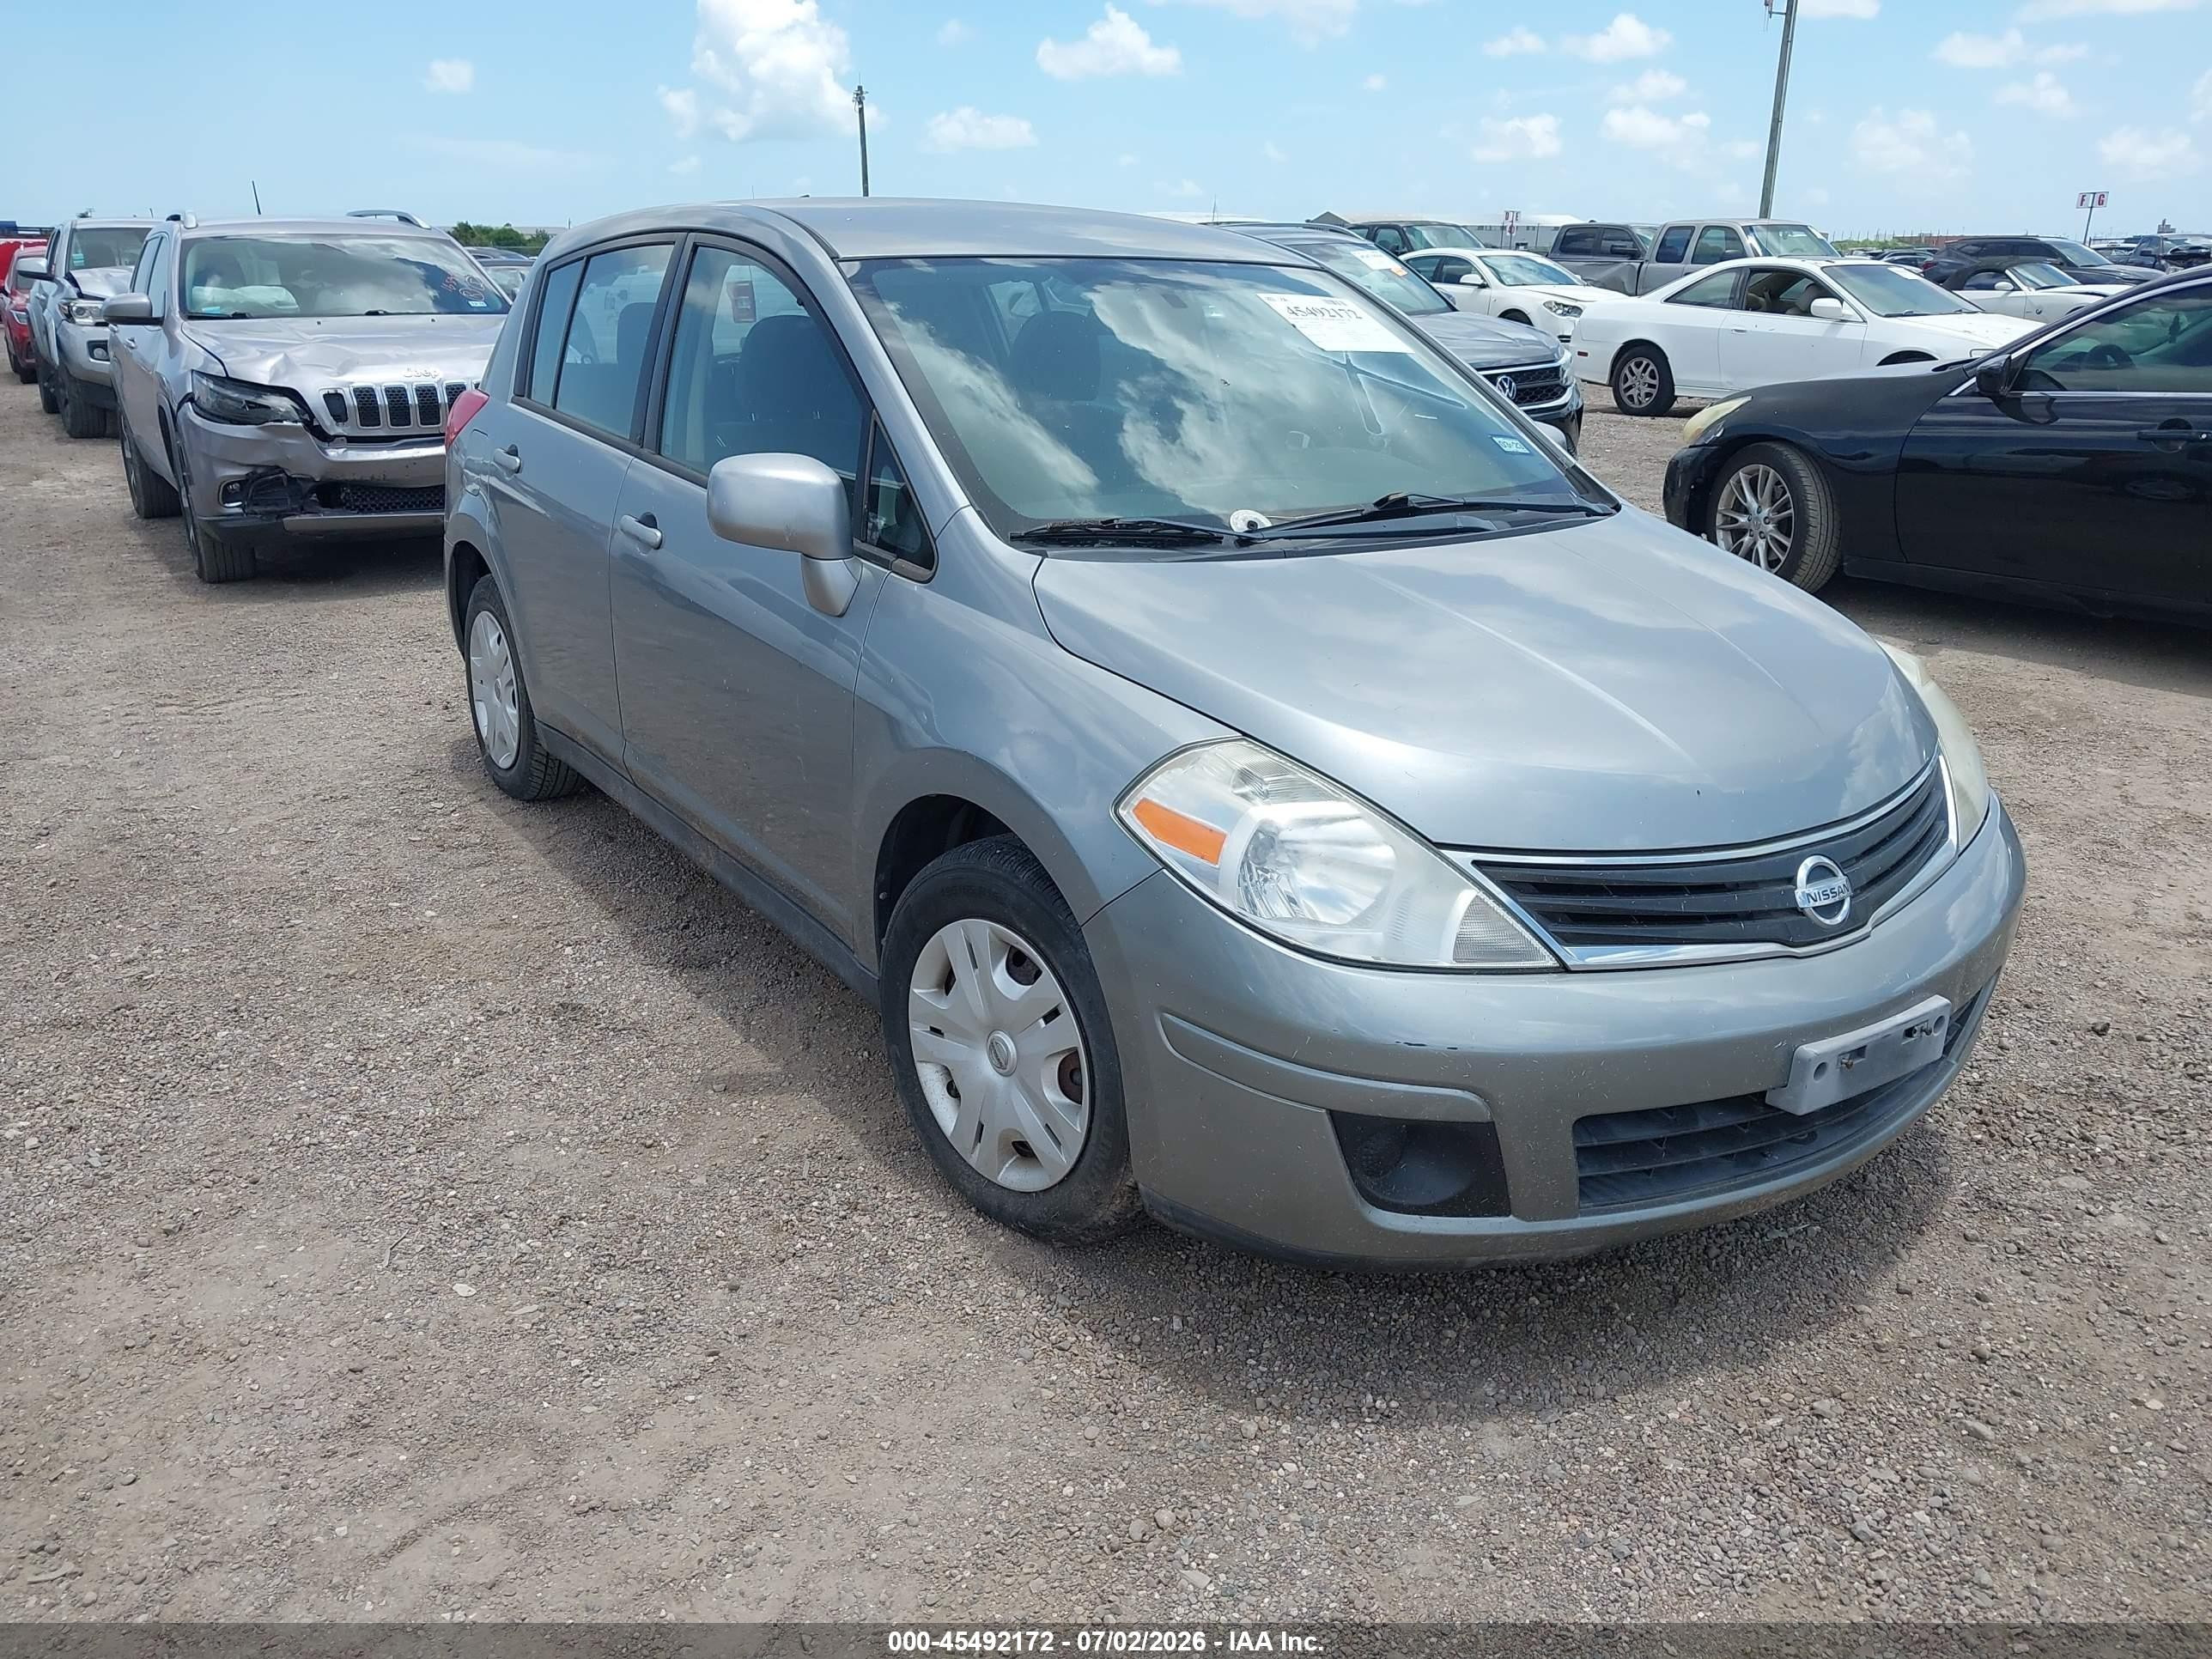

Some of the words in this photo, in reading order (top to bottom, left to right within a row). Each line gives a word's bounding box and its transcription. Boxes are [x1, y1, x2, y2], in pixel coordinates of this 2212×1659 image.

[2079, 194, 2087, 207] F
[2098, 193, 2106, 206] G
[1285, 305, 1363, 319] 45492172
[402, 364, 441, 380] Jeep
[1806, 883, 1850, 904] NISSAN
